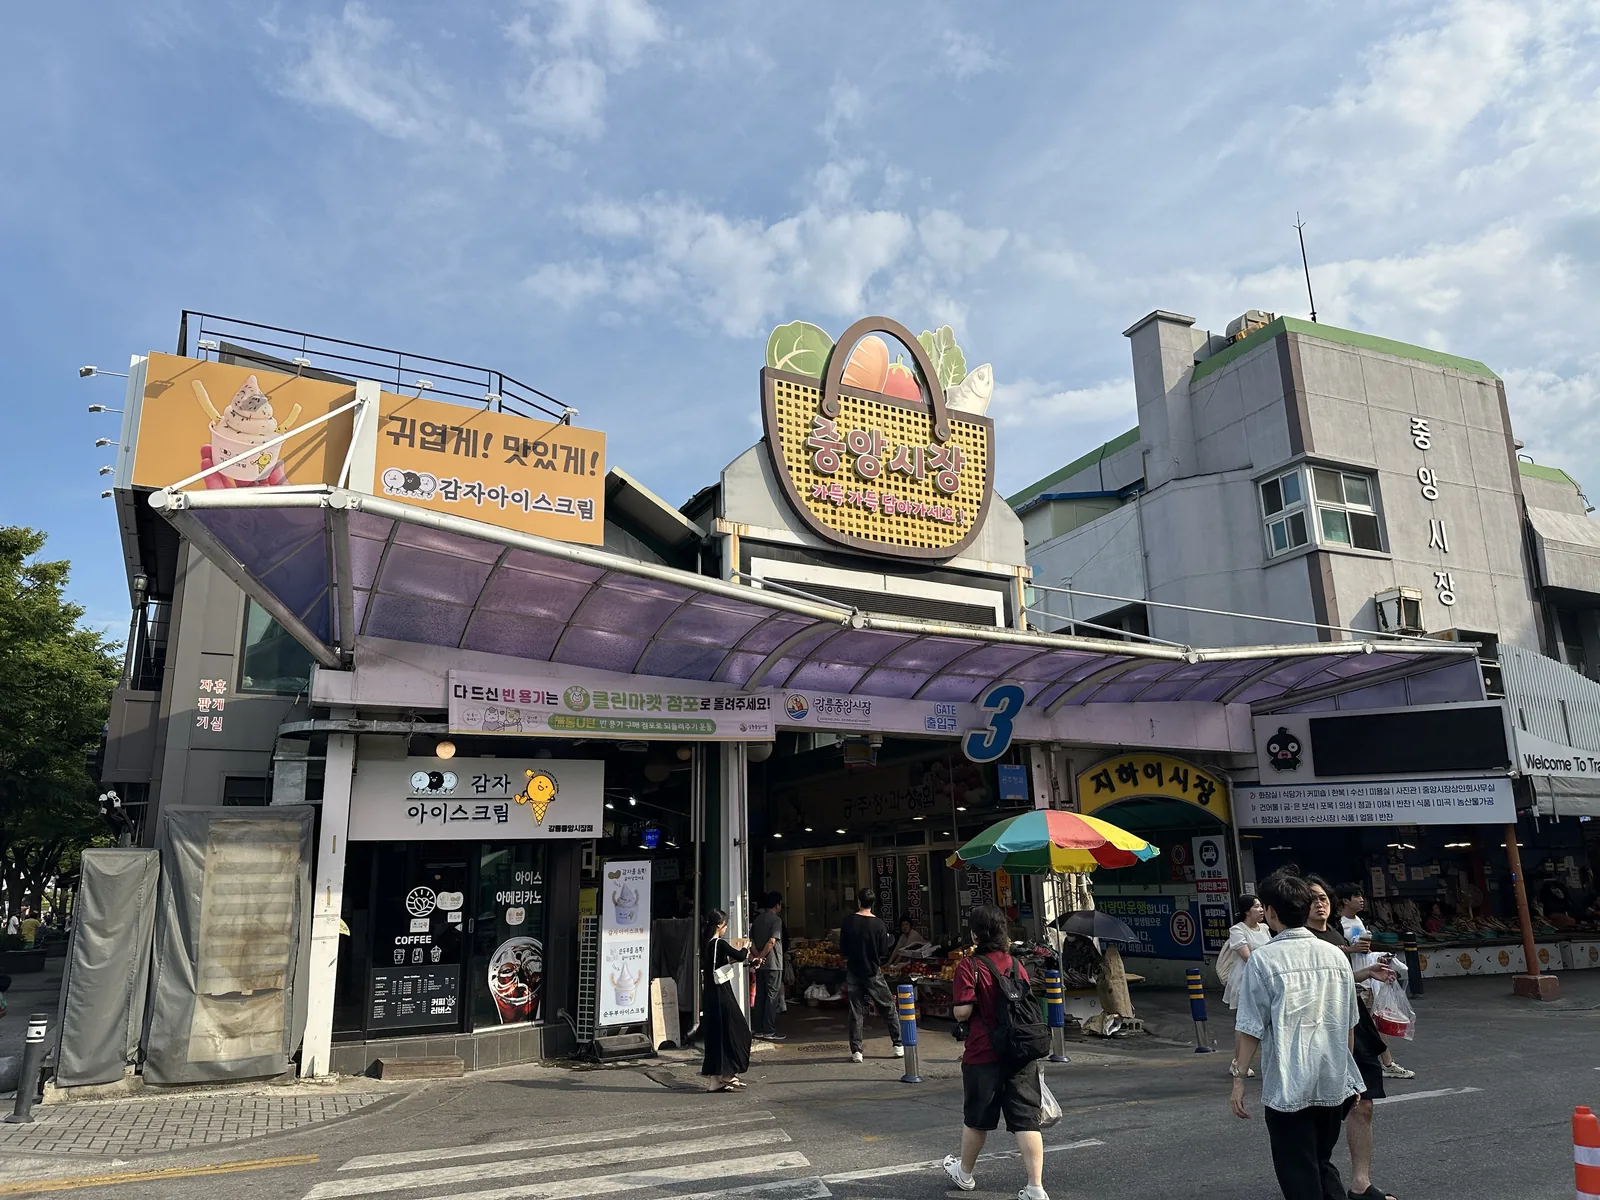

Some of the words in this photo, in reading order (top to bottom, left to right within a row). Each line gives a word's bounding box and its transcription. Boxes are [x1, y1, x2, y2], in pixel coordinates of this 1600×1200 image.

[386, 414, 493, 459] 귀엽게!
[503, 434, 600, 477] 맛있게!
[804, 415, 966, 493] 중앙시장
[438, 477, 595, 521] 감자아이스크림
[812, 483, 844, 506] 가득
[1410, 416, 1456, 606] 중앙시장
[454, 684, 468, 699] 다
[471, 686, 499, 702] 드신
[502, 688, 515, 702] 빈
[519, 689, 558, 705] 용기는
[592, 690, 662, 712] 클린마켓
[666, 695, 711, 712] 점포로
[714, 697, 771, 711] 돌려주세요!
[814, 697, 872, 716] 강릉중앙시장
[936, 704, 957, 716] GATE
[926, 716, 958, 731] 출입구
[962, 682, 1027, 763] 3
[1524, 753, 1571, 772] Welcome
[1573, 757, 1587, 772] To
[471, 774, 511, 794] 감자
[1259, 791, 1278, 799] 화장실
[1283, 790, 1302, 799] 식당가
[1307, 789, 1327, 798] 커피숍
[1332, 788, 1345, 797] 한복
[1351, 788, 1364, 796] 수선
[1369, 787, 1391, 795] 미용실
[1396, 786, 1417, 795] 사진관
[1423, 784, 1495, 794] 중앙시장상인회사무실
[407, 803, 509, 825] 아이스크림
[1260, 803, 1279, 812] 건어물
[1302, 802, 1316, 811] 보석
[1339, 801, 1353, 809] 의상
[1358, 800, 1372, 809] 청과
[1378, 800, 1391, 808] 야채
[1397, 799, 1411, 808] 반찬
[1417, 798, 1431, 807] 식품
[1437, 798, 1451, 807] 미곡
[1457, 797, 1494, 807] 농산물가공
[1261, 815, 1279, 824] 화장실
[1309, 814, 1335, 823] 수산시장
[1341, 814, 1355, 822] 식품
[1379, 813, 1393, 822] 반찬
[548, 824, 593, 833] 강릉중앙시장점
[515, 871, 542, 885] 아이스
[496, 890, 542, 905] 아메리카노
[1099, 900, 1172, 915] 차량만운행합니다.
[1176, 918, 1189, 938] 험
[395, 935, 432, 945] COFFEE
